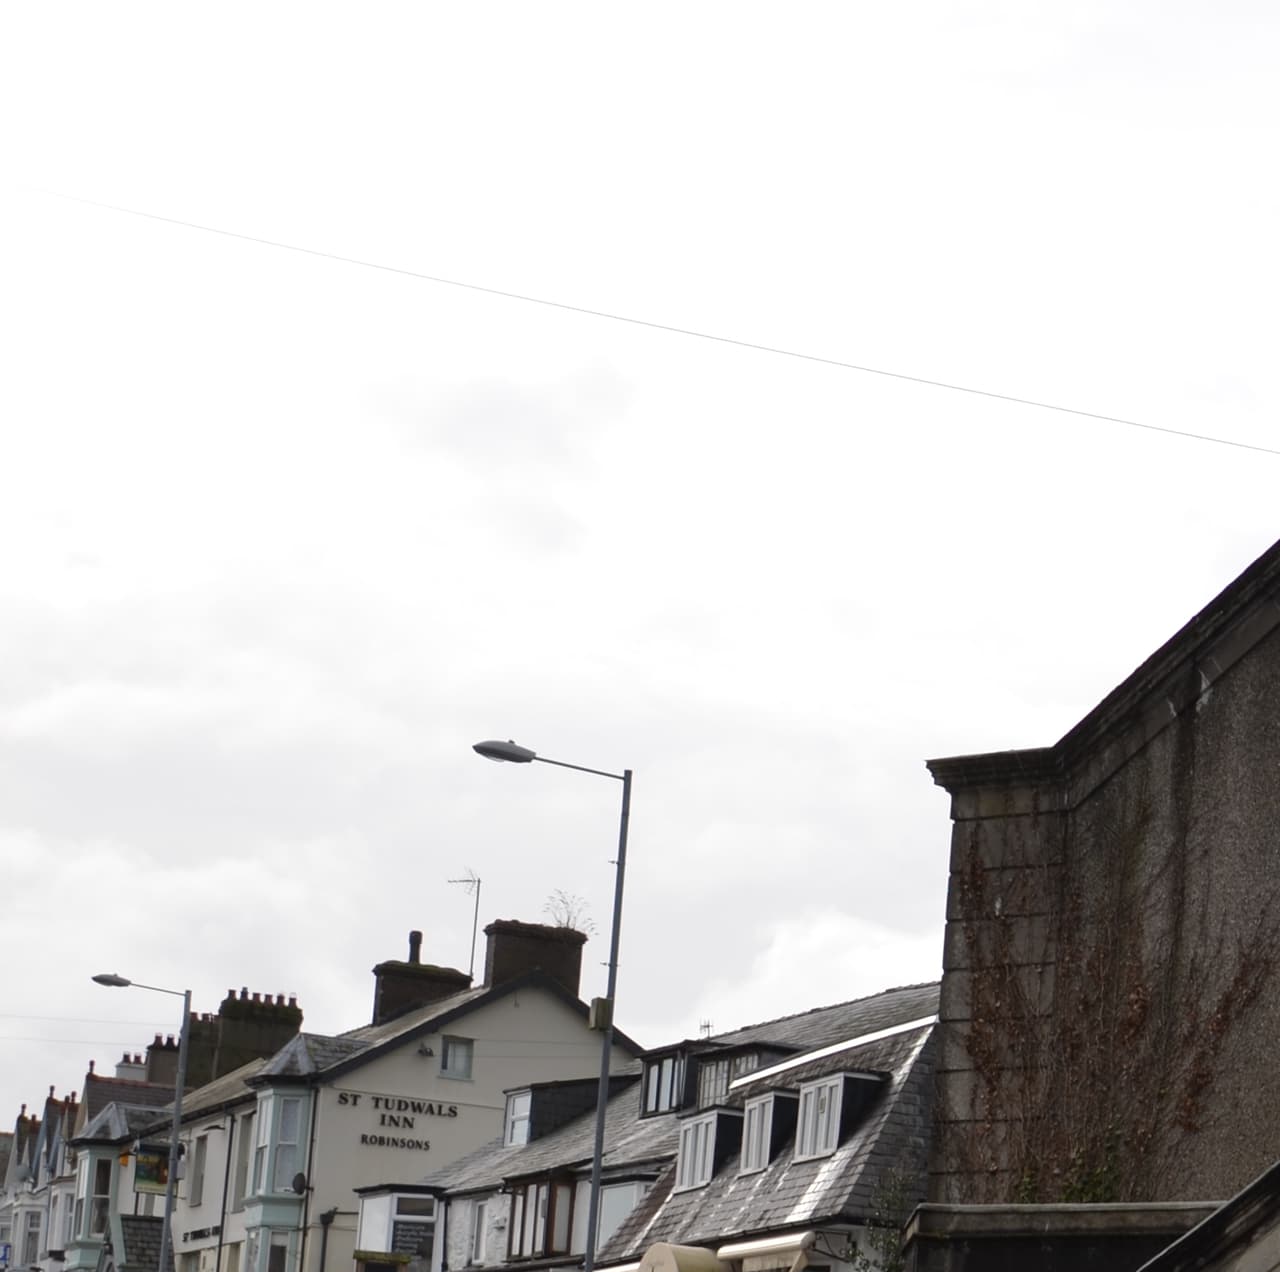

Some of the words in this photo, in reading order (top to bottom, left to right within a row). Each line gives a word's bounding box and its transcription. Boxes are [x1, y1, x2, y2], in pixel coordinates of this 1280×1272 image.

[338, 1092, 361, 1107] ST
[371, 1096, 458, 1118] TUDWALS
[380, 1113, 415, 1129] INN
[361, 1134, 430, 1151] ROBINSONS
